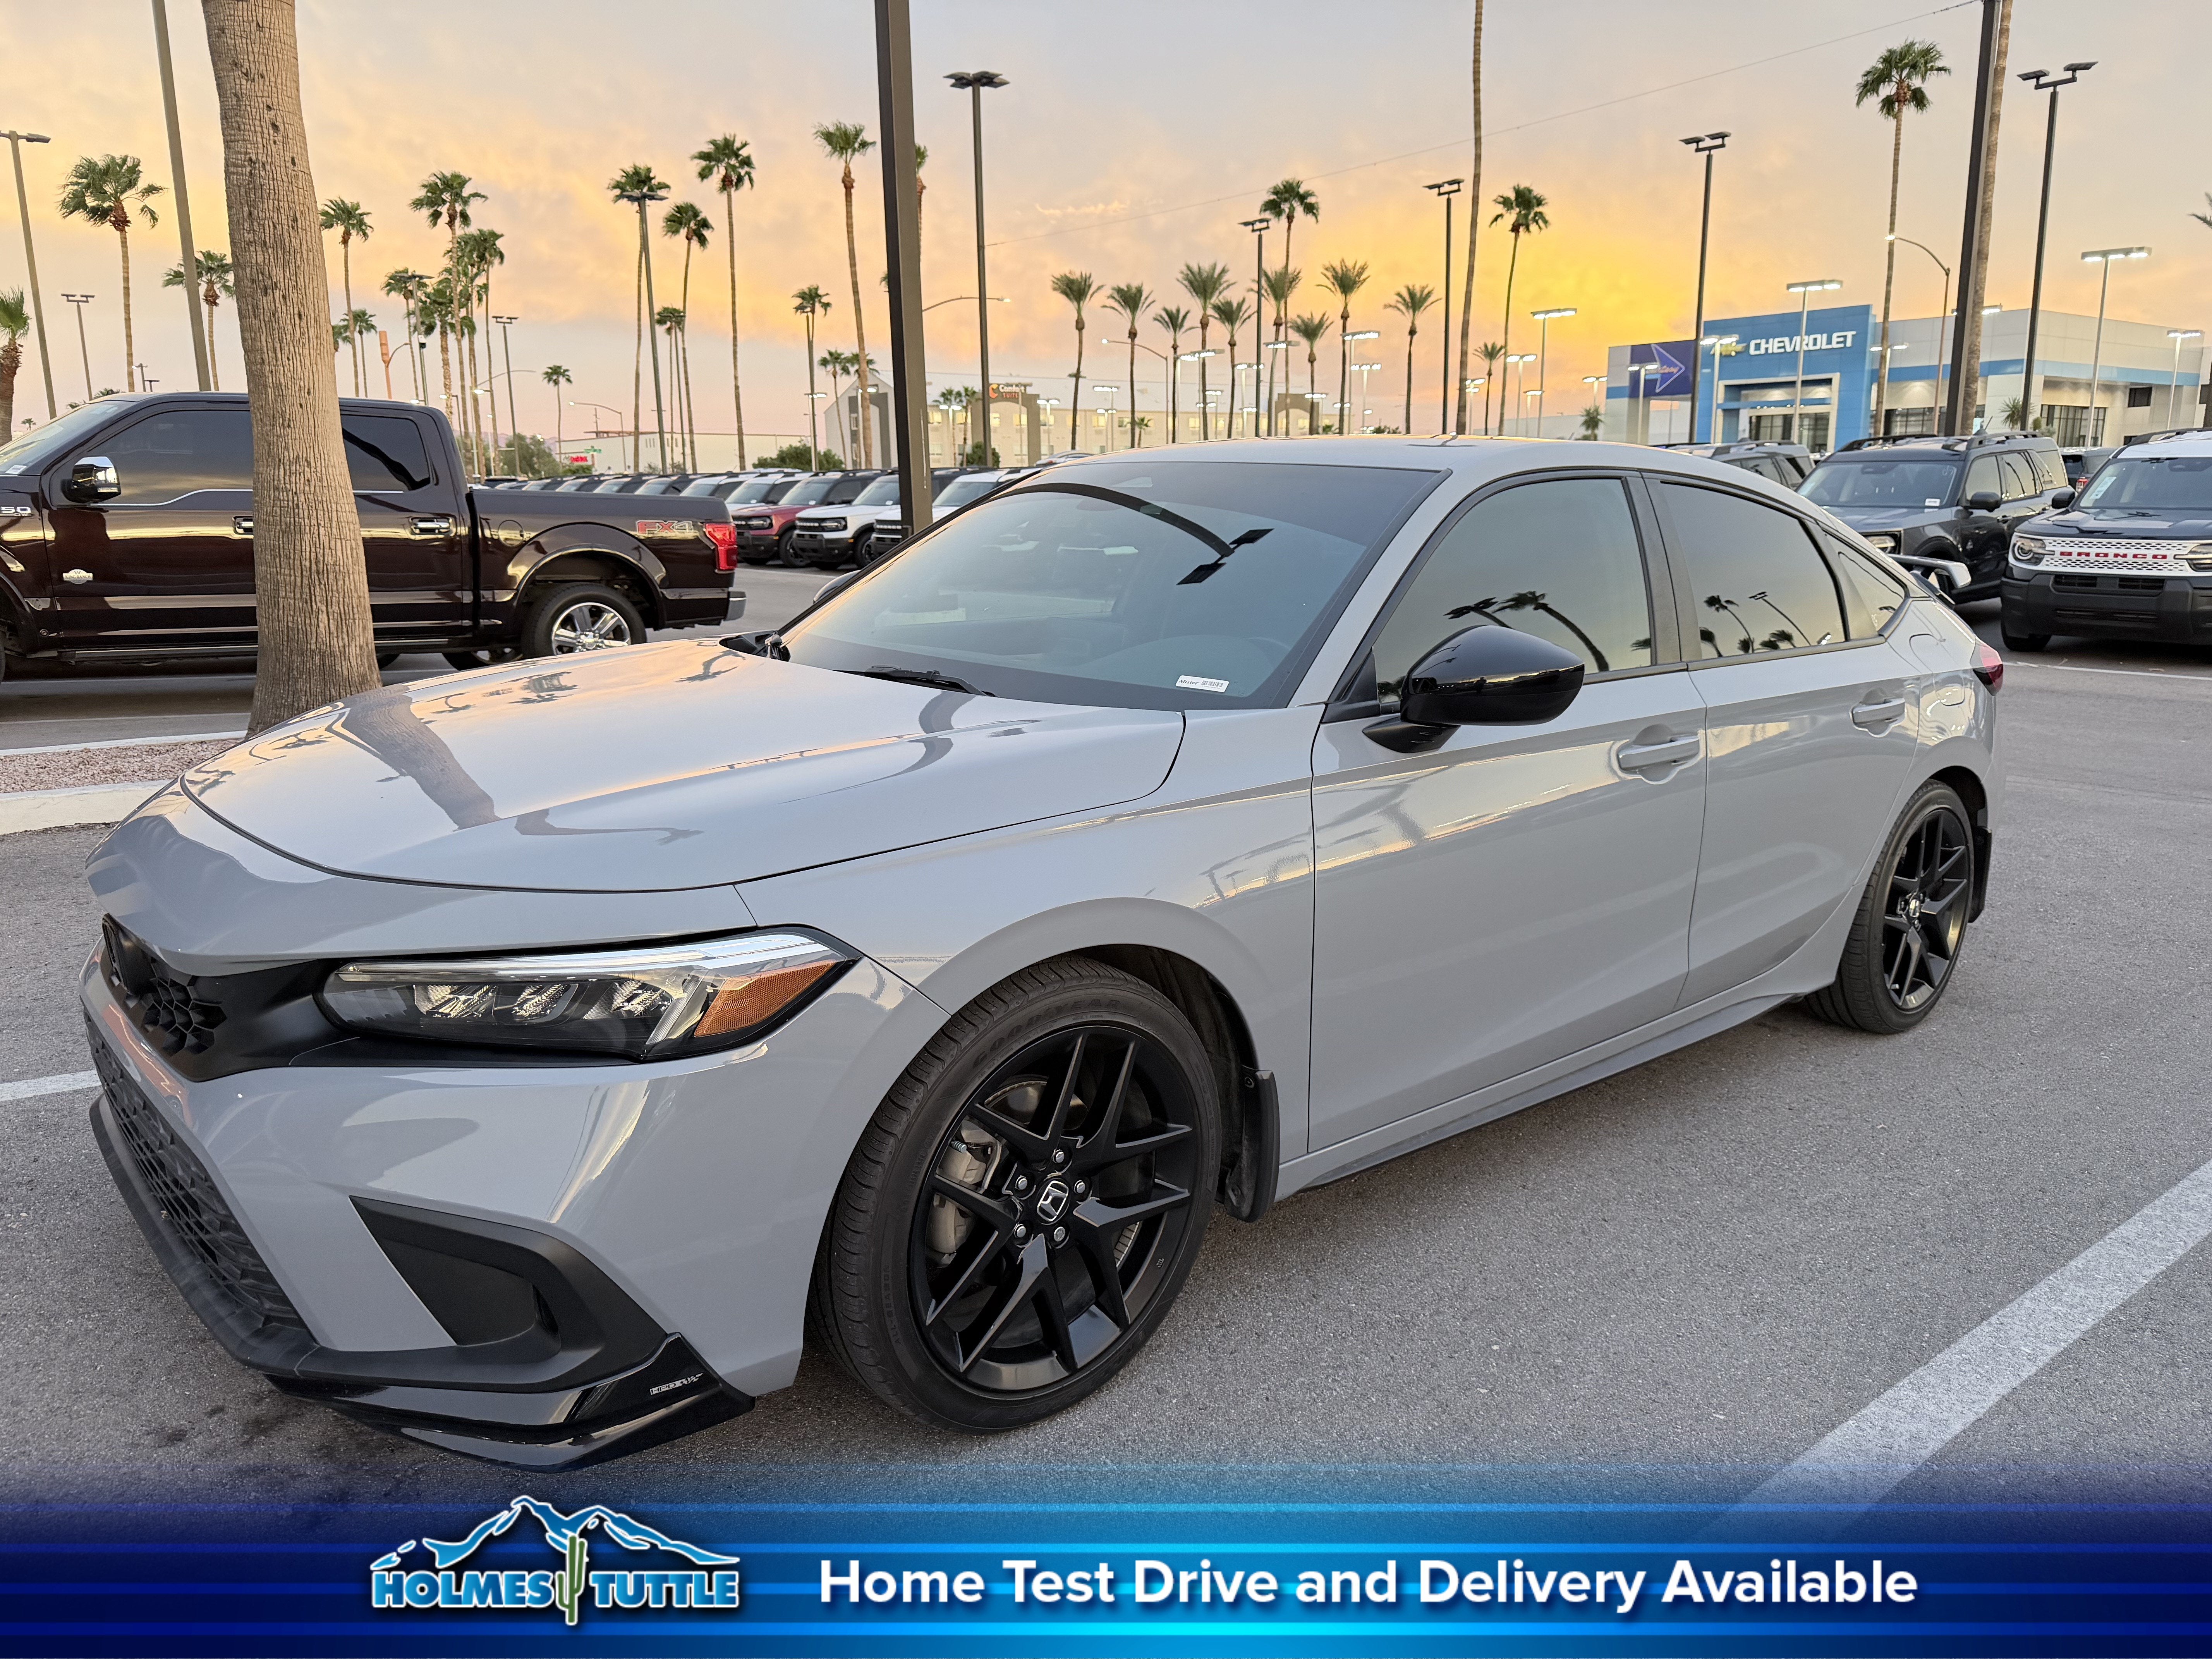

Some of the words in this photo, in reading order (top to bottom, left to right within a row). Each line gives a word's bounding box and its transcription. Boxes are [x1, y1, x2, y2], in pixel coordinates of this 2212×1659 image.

[1749, 331, 1856, 355] CHEVROLET
[636, 520, 694, 535] FX4
[2059, 551, 2167, 560] BRONCO
[972, 999, 1121, 1068] GOODYEAR
[651, 1383, 676, 1394] HPD
